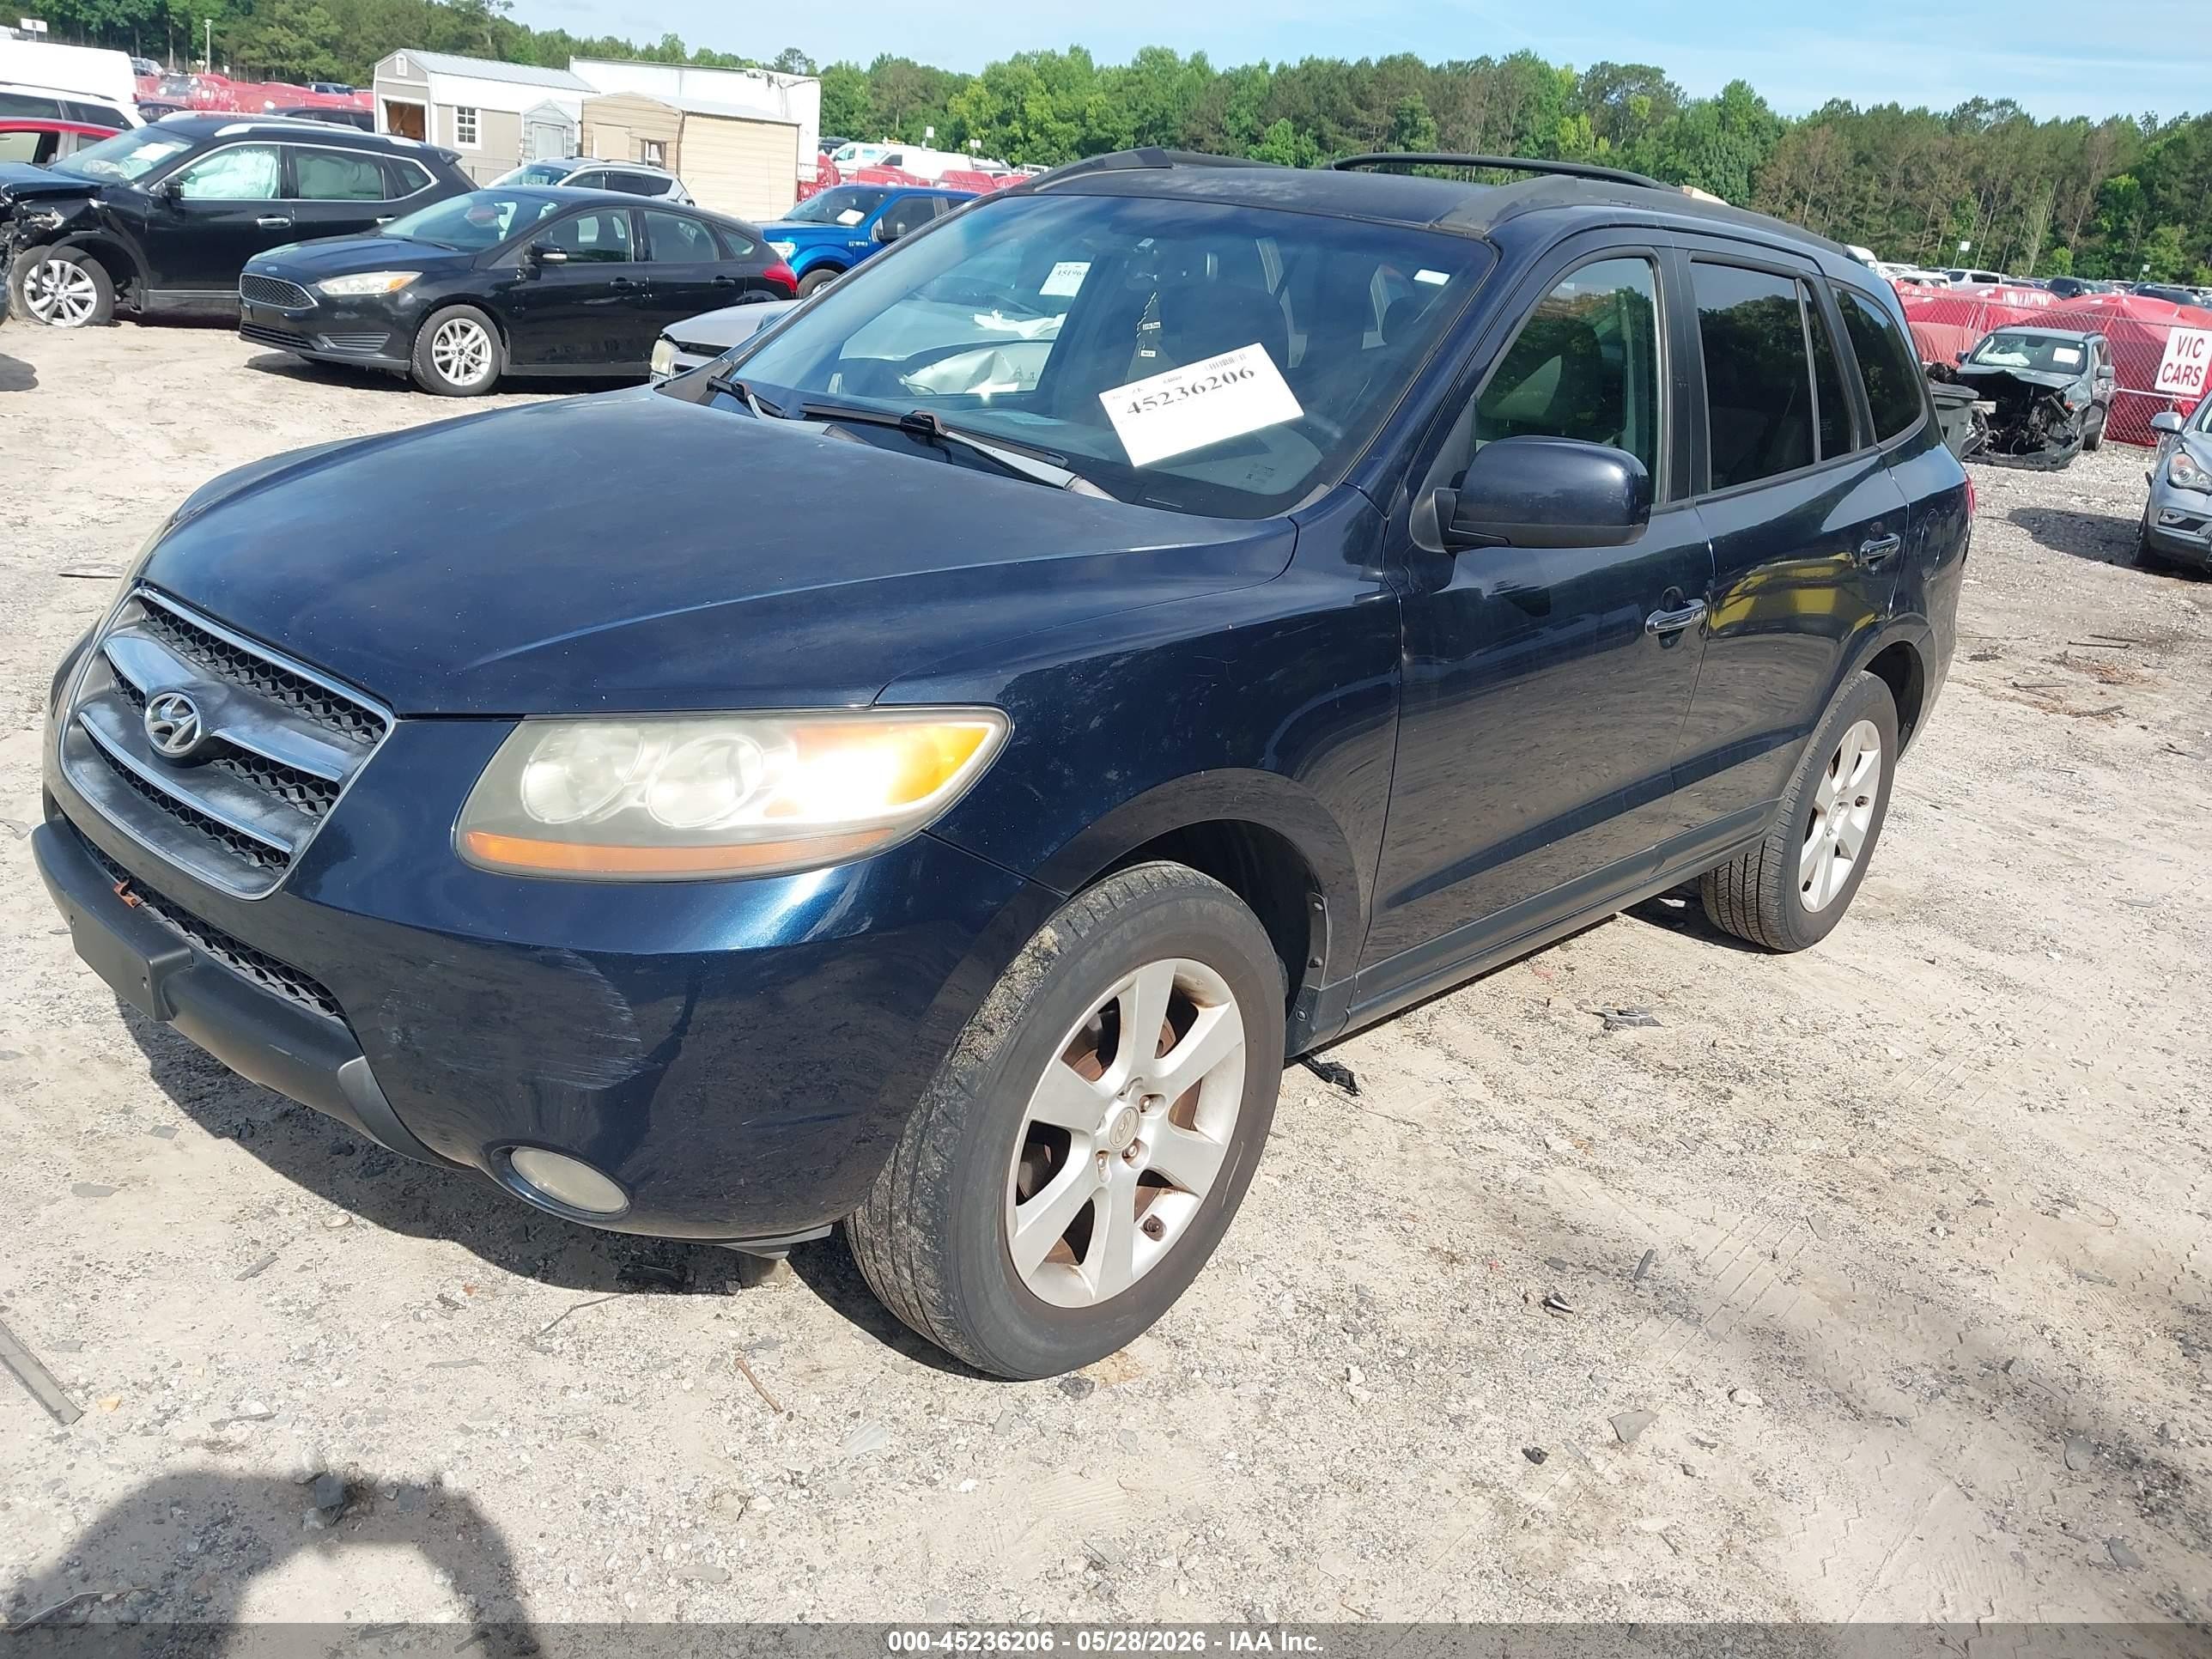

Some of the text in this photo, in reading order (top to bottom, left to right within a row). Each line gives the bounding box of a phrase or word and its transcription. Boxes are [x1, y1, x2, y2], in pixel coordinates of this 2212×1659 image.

[2177, 334, 2205, 359] VIC
[2161, 362, 2203, 387] CARS
[1127, 365, 1255, 415] 45236206
